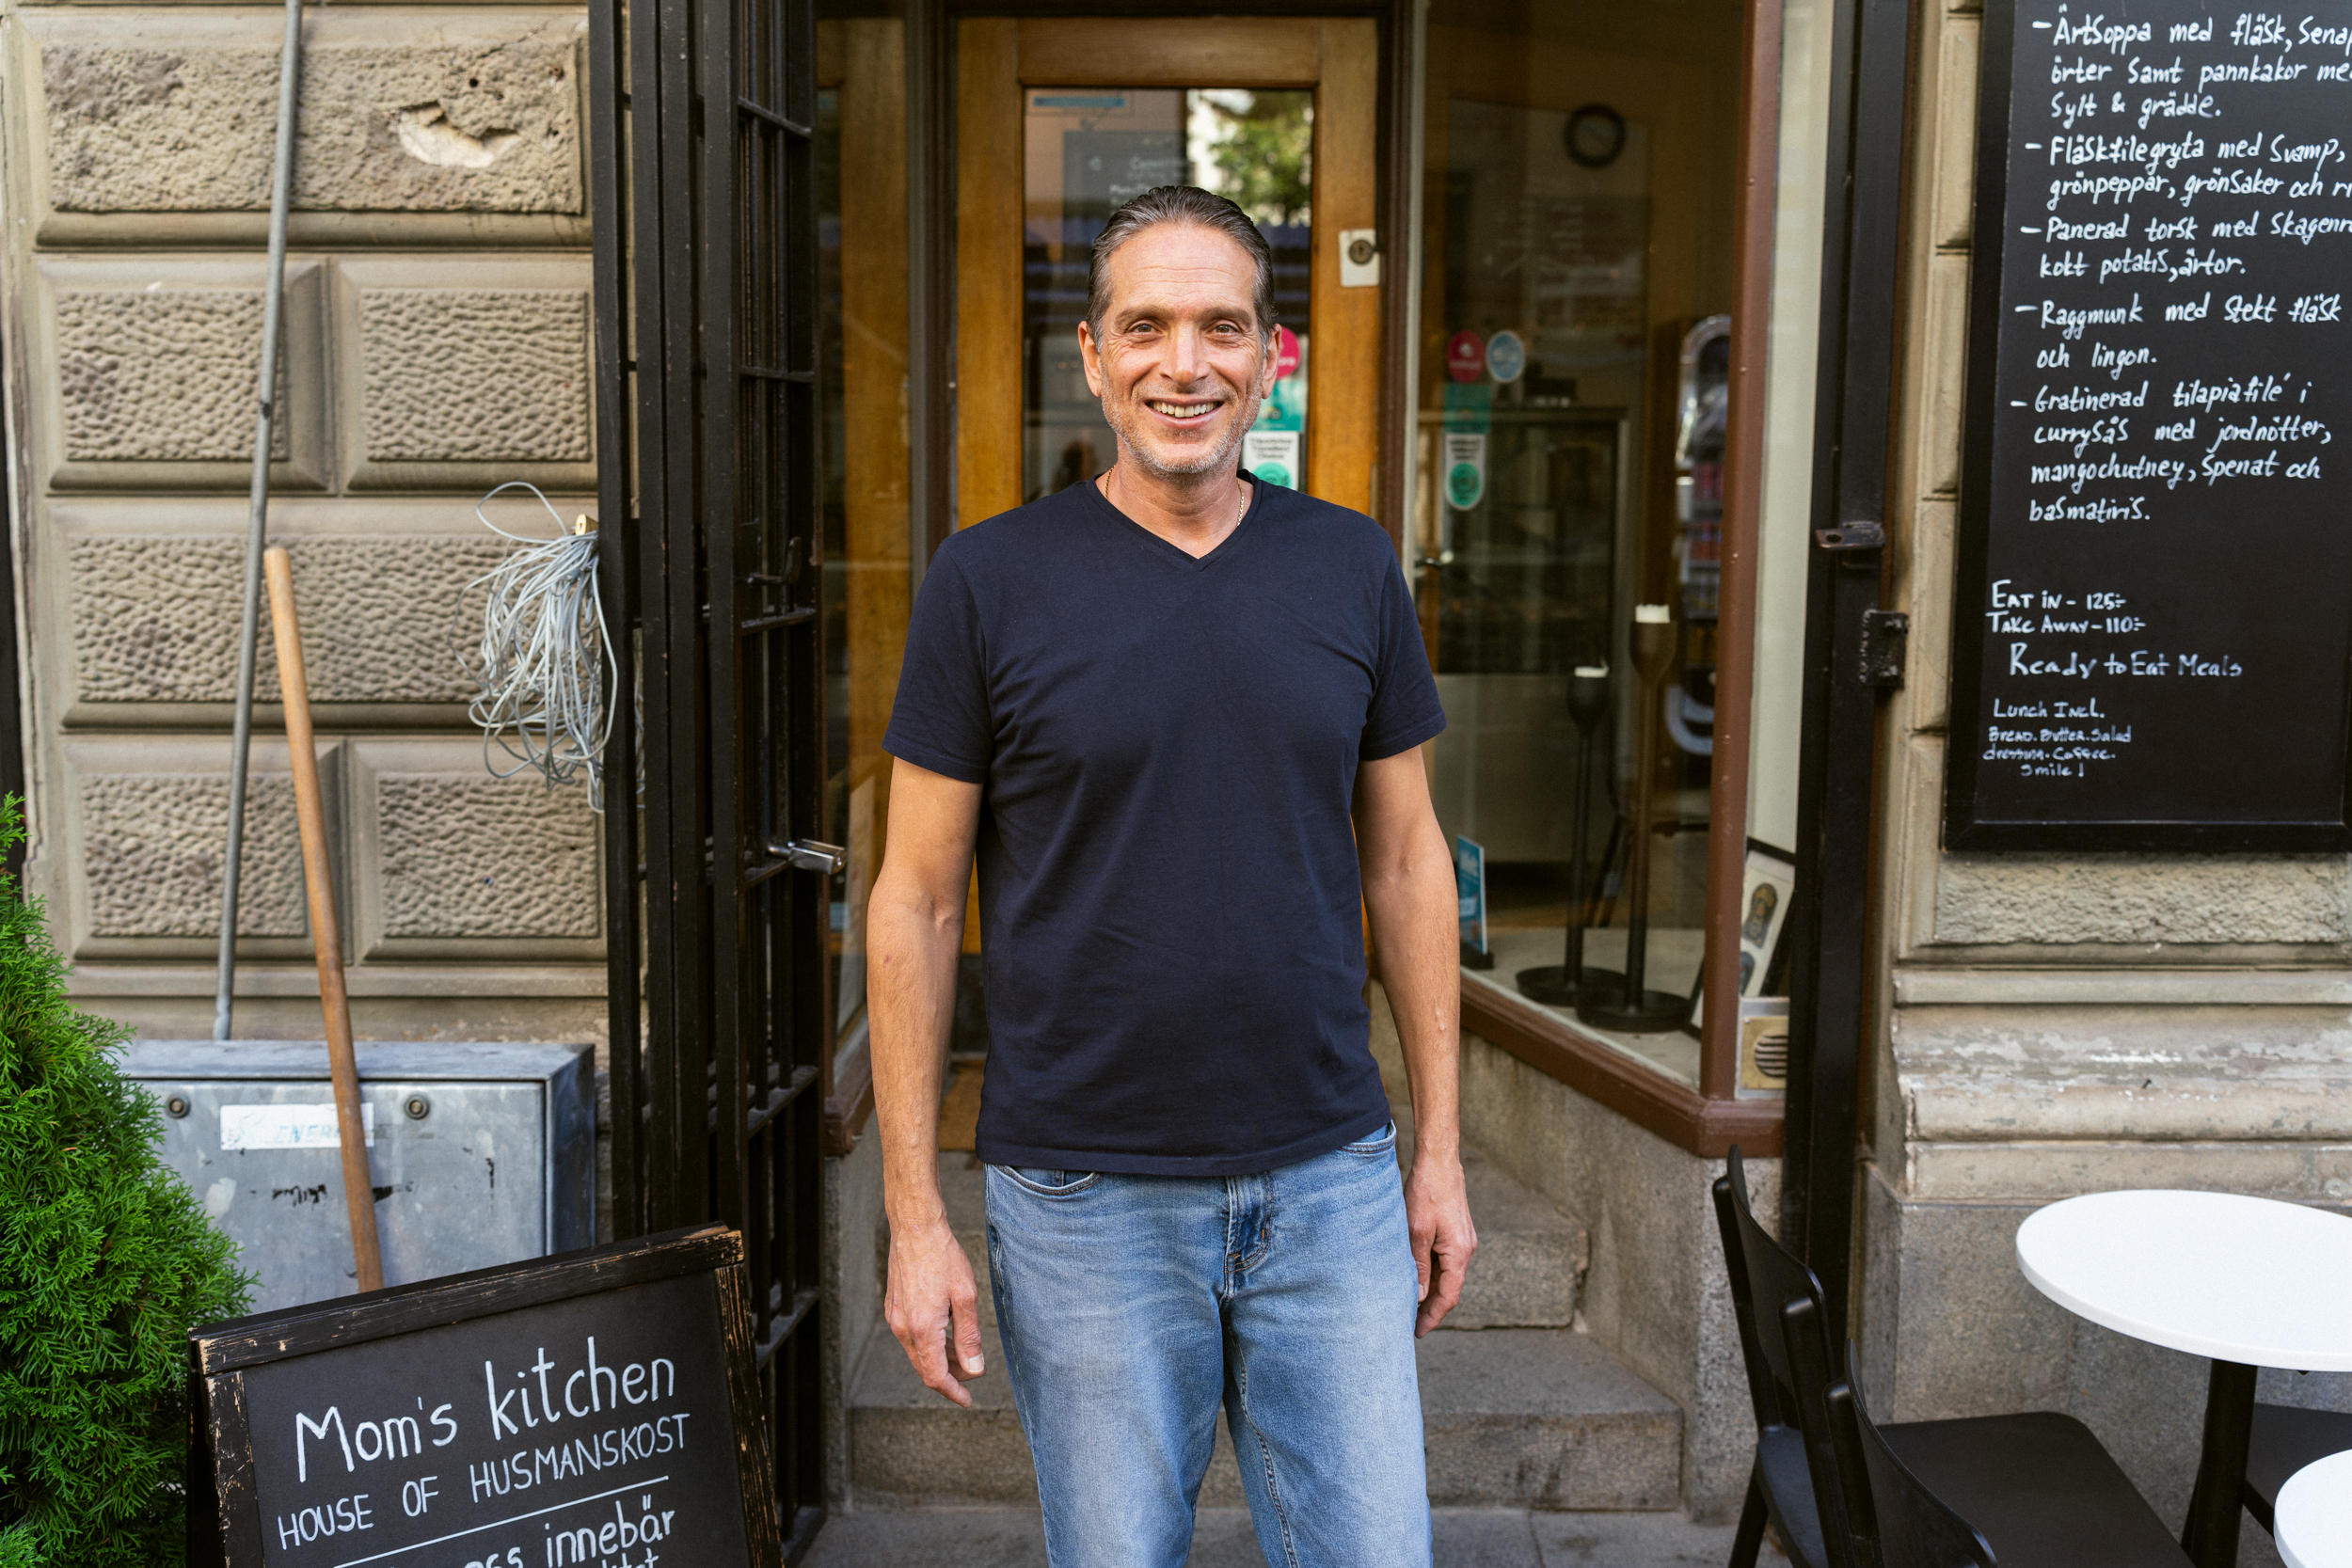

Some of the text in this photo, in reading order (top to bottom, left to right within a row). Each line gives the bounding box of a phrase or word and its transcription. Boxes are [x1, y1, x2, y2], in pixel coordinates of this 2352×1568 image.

[2169, 16, 2214, 44] med
[2230, 12, 2293, 54] fläsk,
[2051, 54, 2352, 94] örter Samt pannkakor me
[2110, 91, 2126, 113] &
[2138, 90, 2222, 130] grädde.
[2217, 131, 2264, 159] med
[2269, 134, 2346, 171] Svamp,
[2046, 170, 2176, 211] grönpeppar,
[2180, 167, 2285, 208] grönsaker
[2288, 171, 2324, 199] och
[2143, 215, 2199, 243] torsk
[2211, 210, 2260, 238] med
[2039, 250, 2090, 278] kokt
[2165, 291, 2211, 322] med
[2287, 293, 2343, 324] fläsk
[2036, 341, 2157, 381] och lingon.
[2299, 381, 2312, 404] i
[2033, 415, 2332, 459] currysås med jordnötter,
[2030, 451, 2197, 495] mangochutney,
[2284, 455, 2321, 480] och
[2028, 495, 2151, 524] basmatiris.
[2010, 641, 2243, 680] Ready to Eat Meals
[1993, 698, 2048, 718] Lunch
[295, 1336, 675, 1482] Mom's kitchen
[278, 1412, 691, 1551] HOUSE OF HUSMANSKOST
[542, 1493, 675, 1568] innebär
